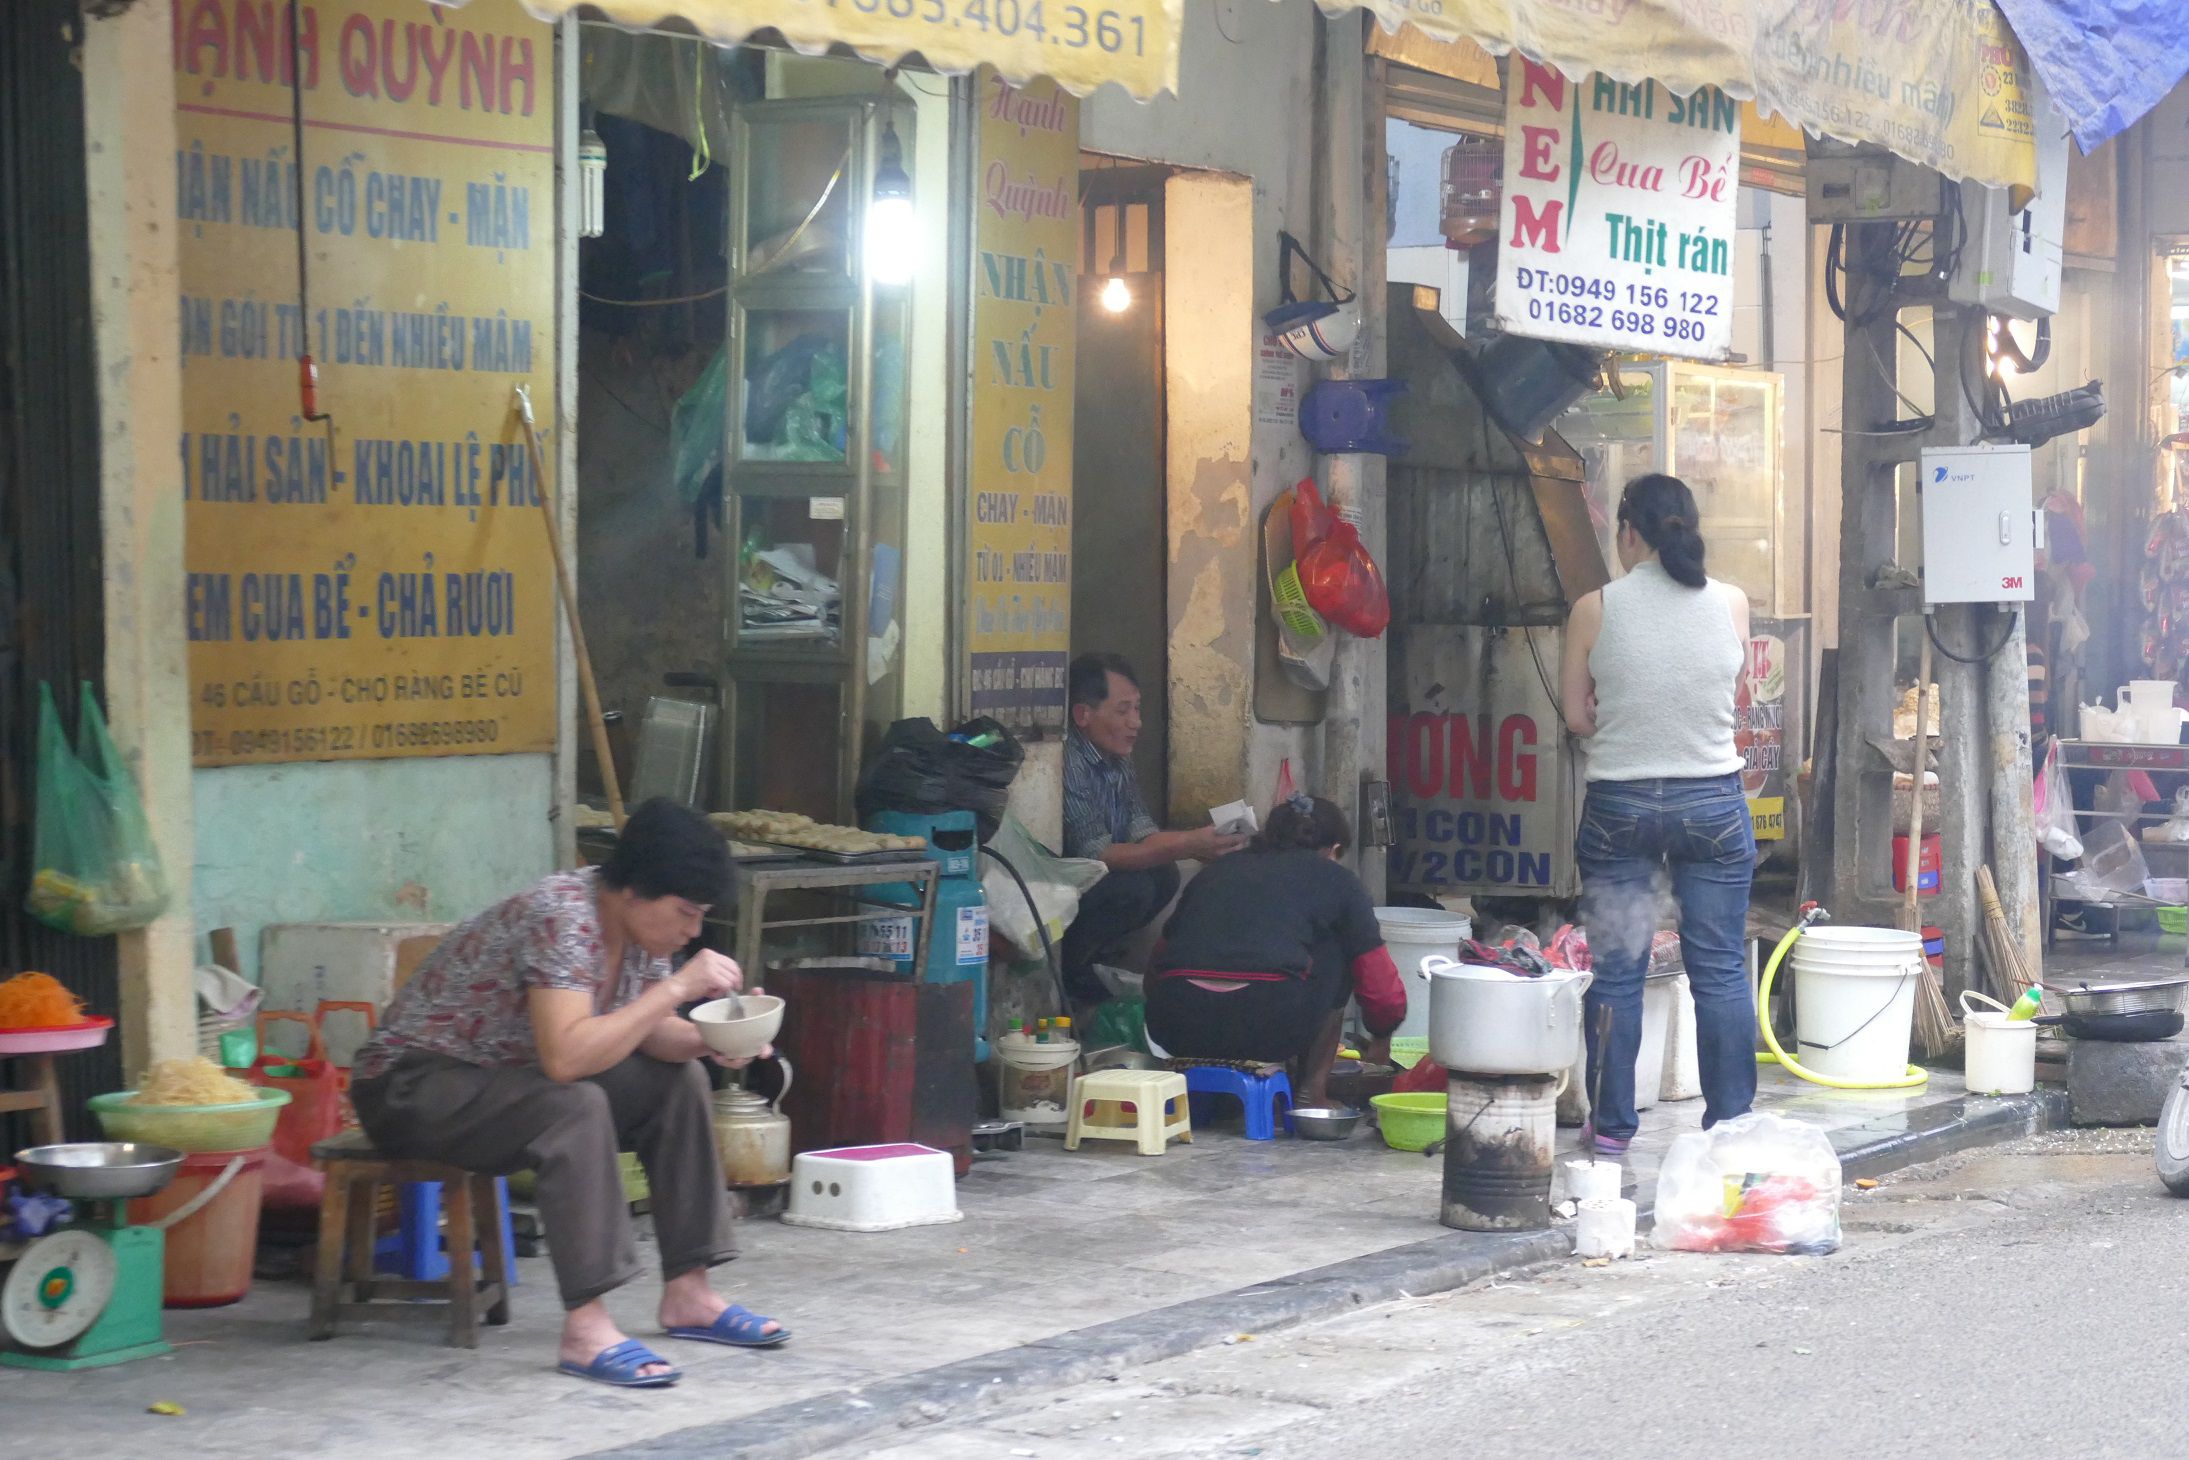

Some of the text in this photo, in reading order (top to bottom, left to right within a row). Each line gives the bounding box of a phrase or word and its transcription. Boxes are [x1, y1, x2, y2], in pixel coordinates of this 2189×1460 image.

[173, 0, 535, 118] ẠNH QUỲNH
[366, 171, 442, 244] CHAY
[986, 160, 1070, 223] Quỳnh
[1604, 212, 1728, 277] Thịt rán
[1529, 298, 1705, 342] 01682 698 980
[1625, 283, 1669, 310] 156
[1680, 290, 1719, 317] 122
[472, 308, 532, 374] MÂM
[201, 412, 256, 504] HẢI
[265, 415, 328, 504] SẢN
[354, 439, 446, 506] KHOAI
[454, 430, 482, 523] LỆ
[1951, 474, 1976, 482] VNPT
[976, 491, 1019, 524] CHAY
[240, 572, 307, 642] CUA
[378, 551, 439, 639] CHẢ
[2001, 576, 2023, 589] 3M
